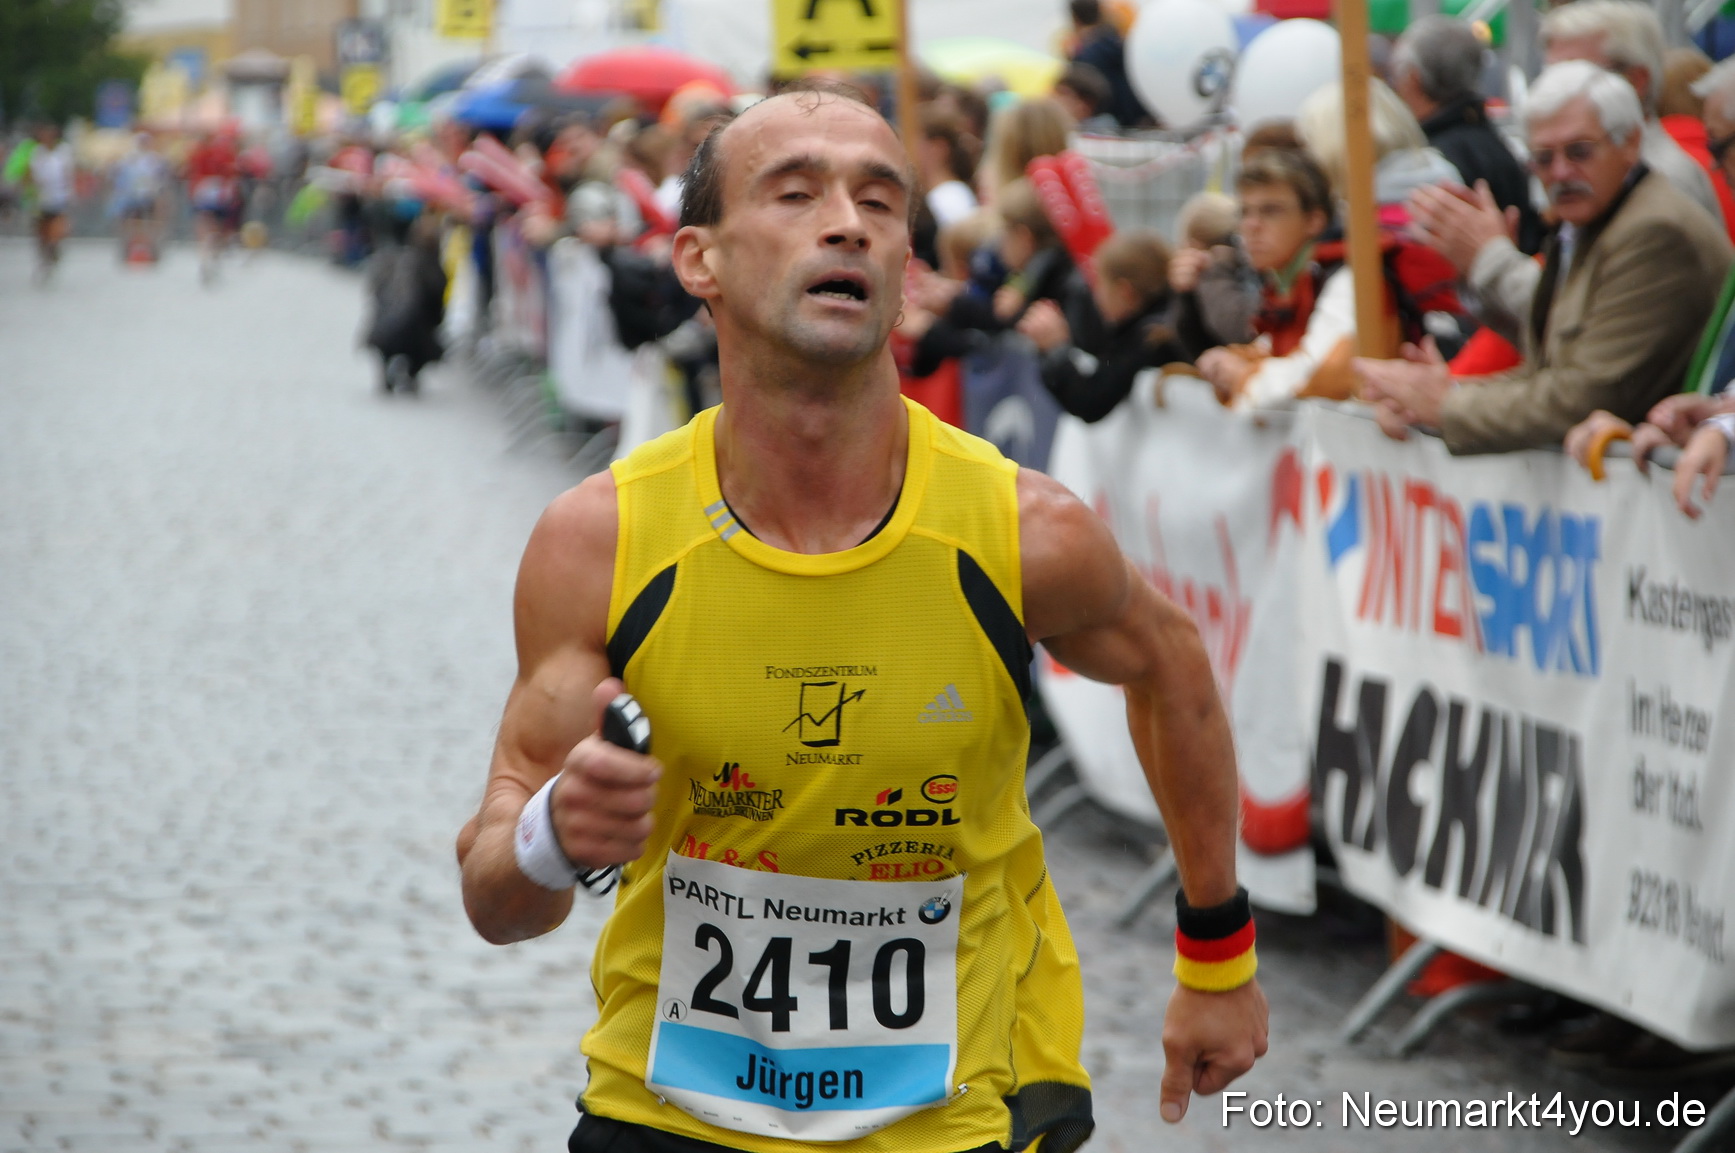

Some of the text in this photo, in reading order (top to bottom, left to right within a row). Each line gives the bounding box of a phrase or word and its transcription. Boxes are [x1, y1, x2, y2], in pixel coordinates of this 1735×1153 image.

[917, 710, 975, 723] adidas
[851, 841, 954, 866] PIZZERIA
[868, 858, 944, 881] ELIO
[668, 877, 906, 926] PARTL Neumarkt
[690, 923, 926, 1032] 2410
[736, 1053, 863, 1109] Jürgen
